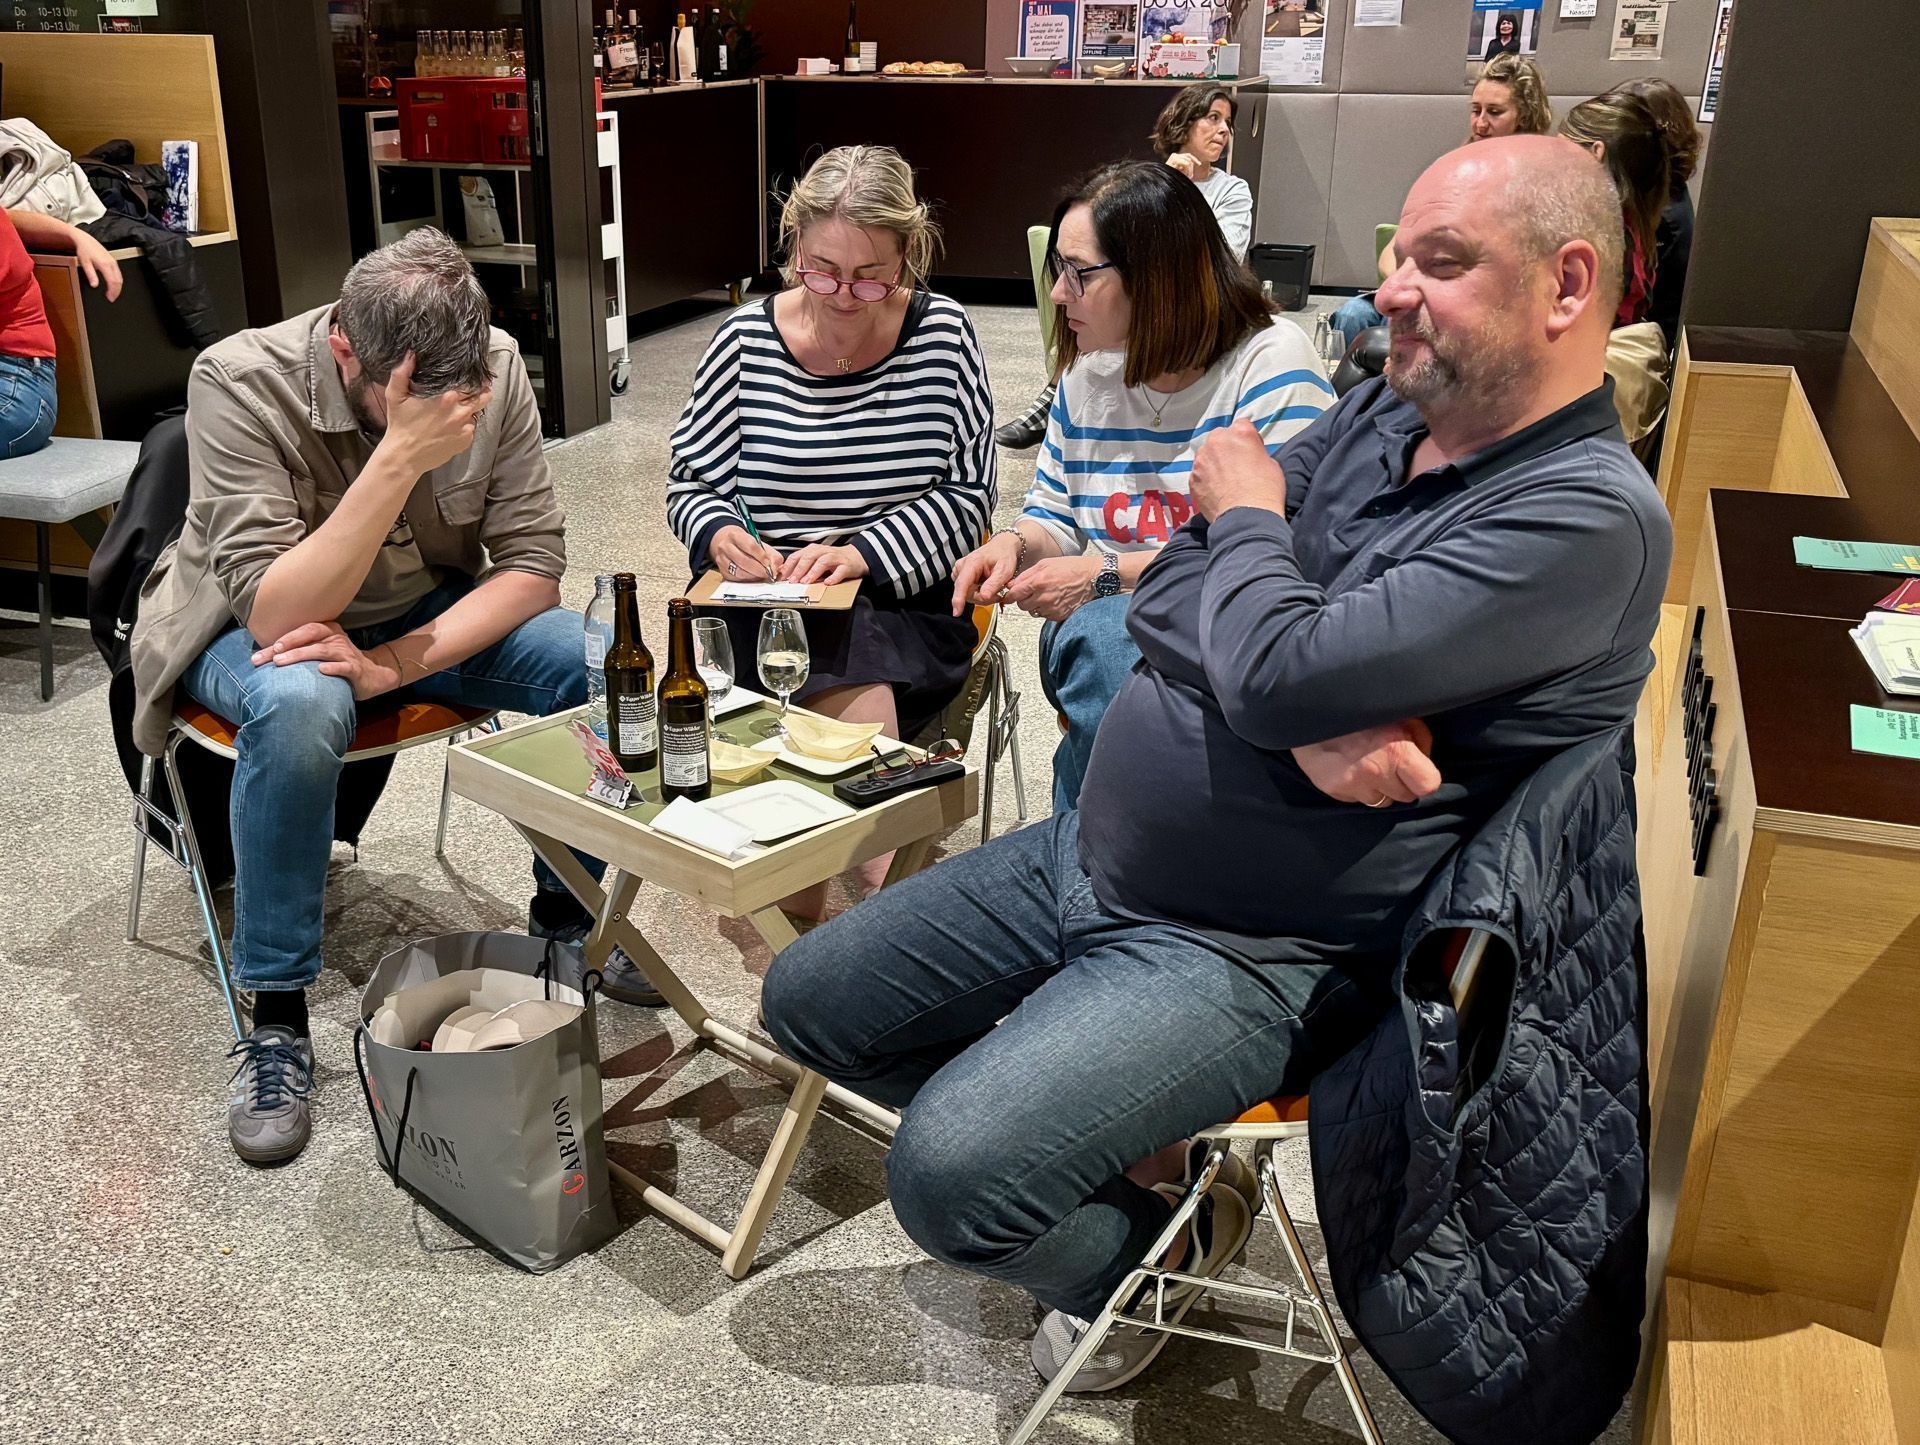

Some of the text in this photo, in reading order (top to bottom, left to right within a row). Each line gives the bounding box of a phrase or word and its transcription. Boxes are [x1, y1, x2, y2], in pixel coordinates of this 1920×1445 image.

[14, 7, 26, 17] Do
[64, 7, 78, 17] Uhr
[17, 21, 25, 31] Fr
[66, 21, 80, 31] Uhr
[1103, 489, 1199, 544] CAP
[552, 1095, 584, 1195] CARZON
